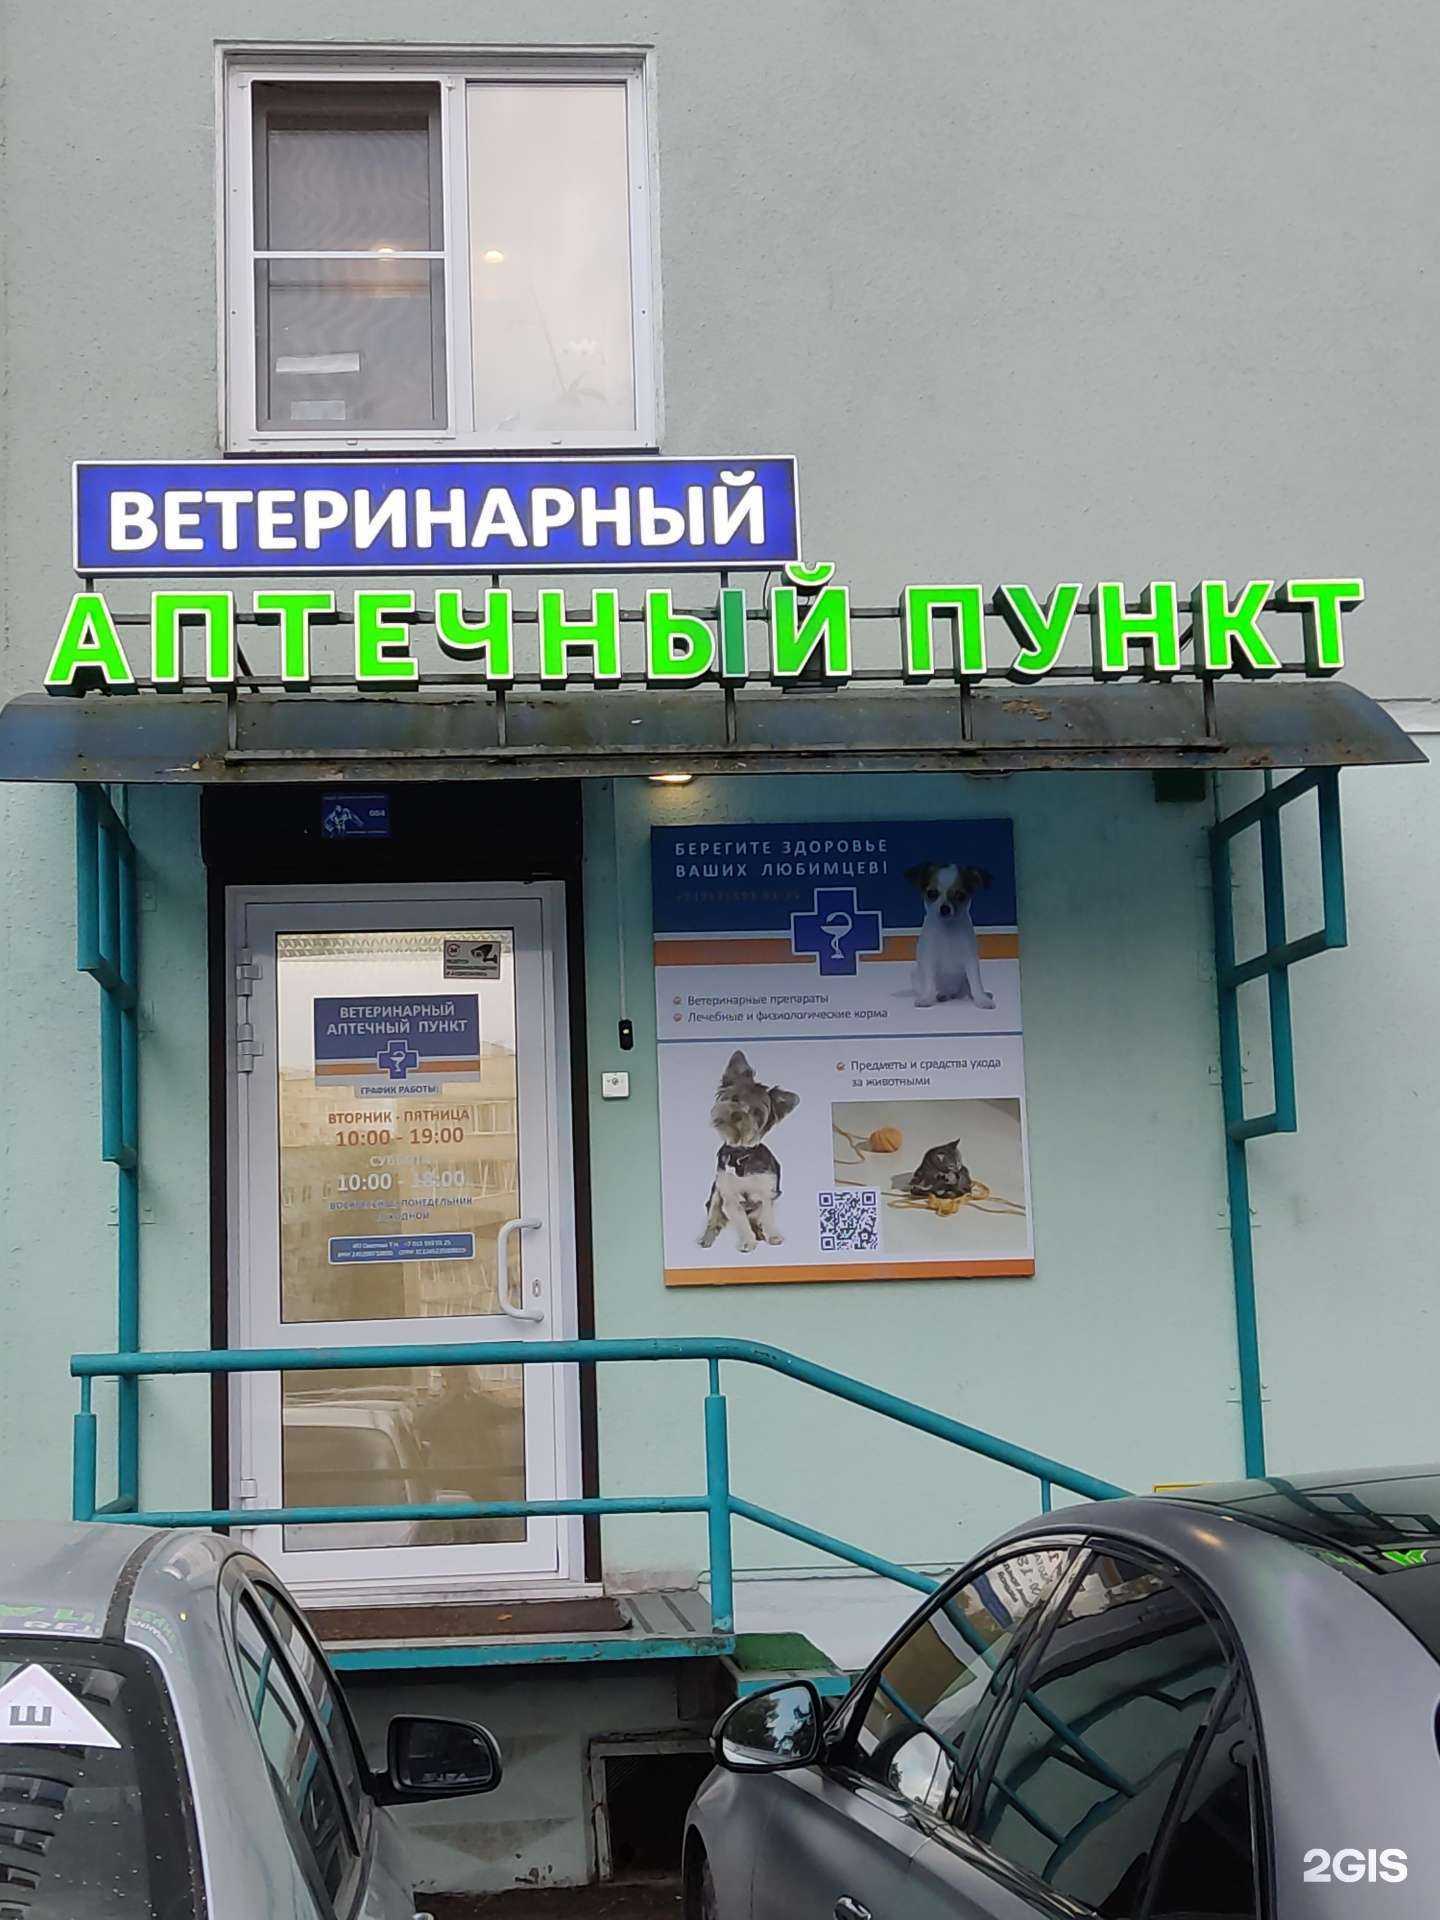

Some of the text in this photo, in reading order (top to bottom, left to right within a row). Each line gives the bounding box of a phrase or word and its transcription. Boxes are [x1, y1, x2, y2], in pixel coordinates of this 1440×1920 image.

[109, 470, 767, 552] ВЕТЕРИНАРНЫЙ
[43, 561, 1364, 688] АПТЕЧНЫЙ ПУНКТ
[675, 839, 888, 856] БЕРЕГИТЕ ЗДОРОВЬЕ
[675, 864, 748, 878] ВАШИХ
[687, 993, 829, 1007] Ветеринарные препараты
[339, 1002, 455, 1018] ВЕТЕРИНАРНЫЙ
[687, 1009, 889, 1023] Лечебные и физиологические корма
[327, 1018, 468, 1036] АПТЕЧНЫЙ ПУНКТ
[850, 1058, 1002, 1072] Предметы и средства ухода
[852, 1076, 931, 1087] за животными
[328, 1111, 393, 1124] ВТОРНИК
[404, 1109, 471, 1122] ПЯТНИЦА
[335, 1129, 391, 1147] 10:00
[410, 1127, 464, 1144] 19:00
[337, 1172, 392, 1192] 10:00
[9, 1705, 53, 1727] Ш
